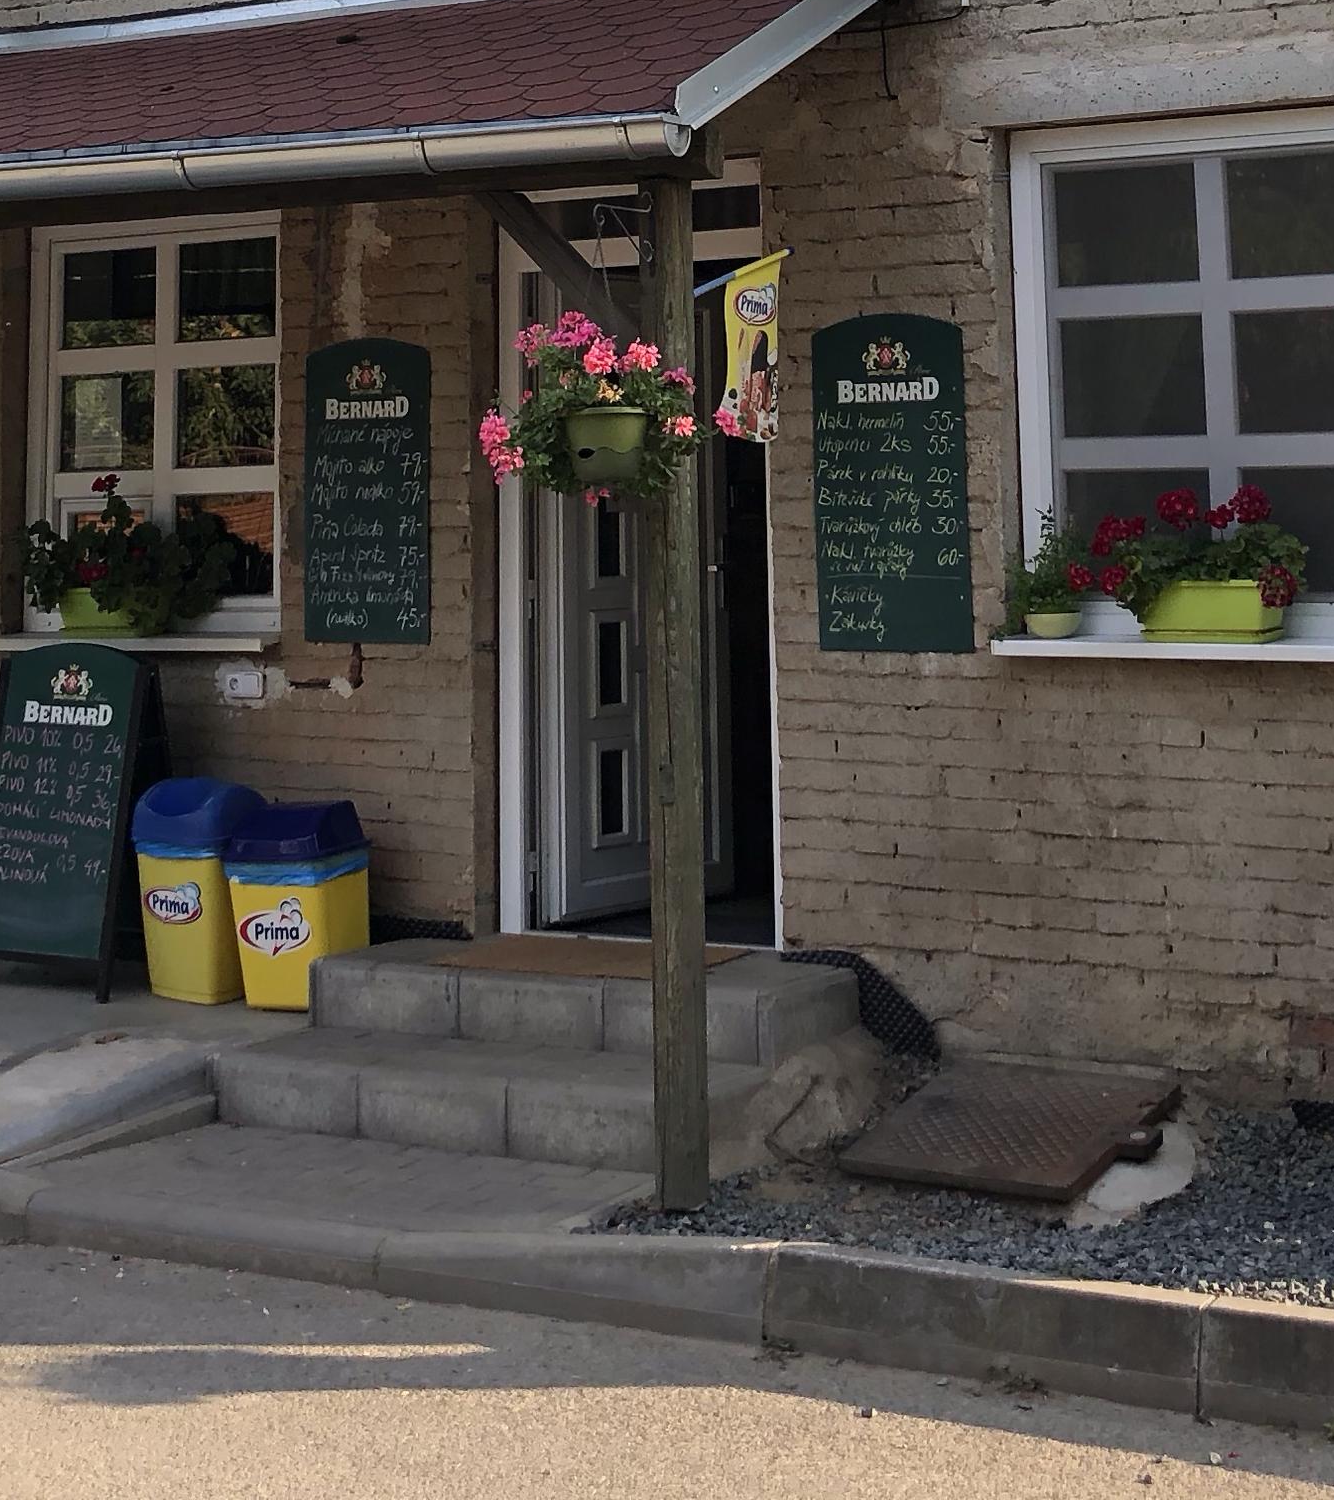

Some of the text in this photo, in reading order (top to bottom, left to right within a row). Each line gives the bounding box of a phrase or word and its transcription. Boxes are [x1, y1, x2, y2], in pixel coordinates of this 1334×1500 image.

[740, 295, 769, 316] Prima
[837, 377, 940, 404] BERNARD
[325, 396, 409, 420] BERNARD
[880, 432, 913, 452] 2ks
[23, 700, 113, 726] BERNARD
[4, 725, 35, 745] PIVO
[73, 731, 94, 756] 0,5
[0, 750, 29, 770] PIVO
[152, 894, 190, 915] Prima
[255, 921, 300, 941] Prima
